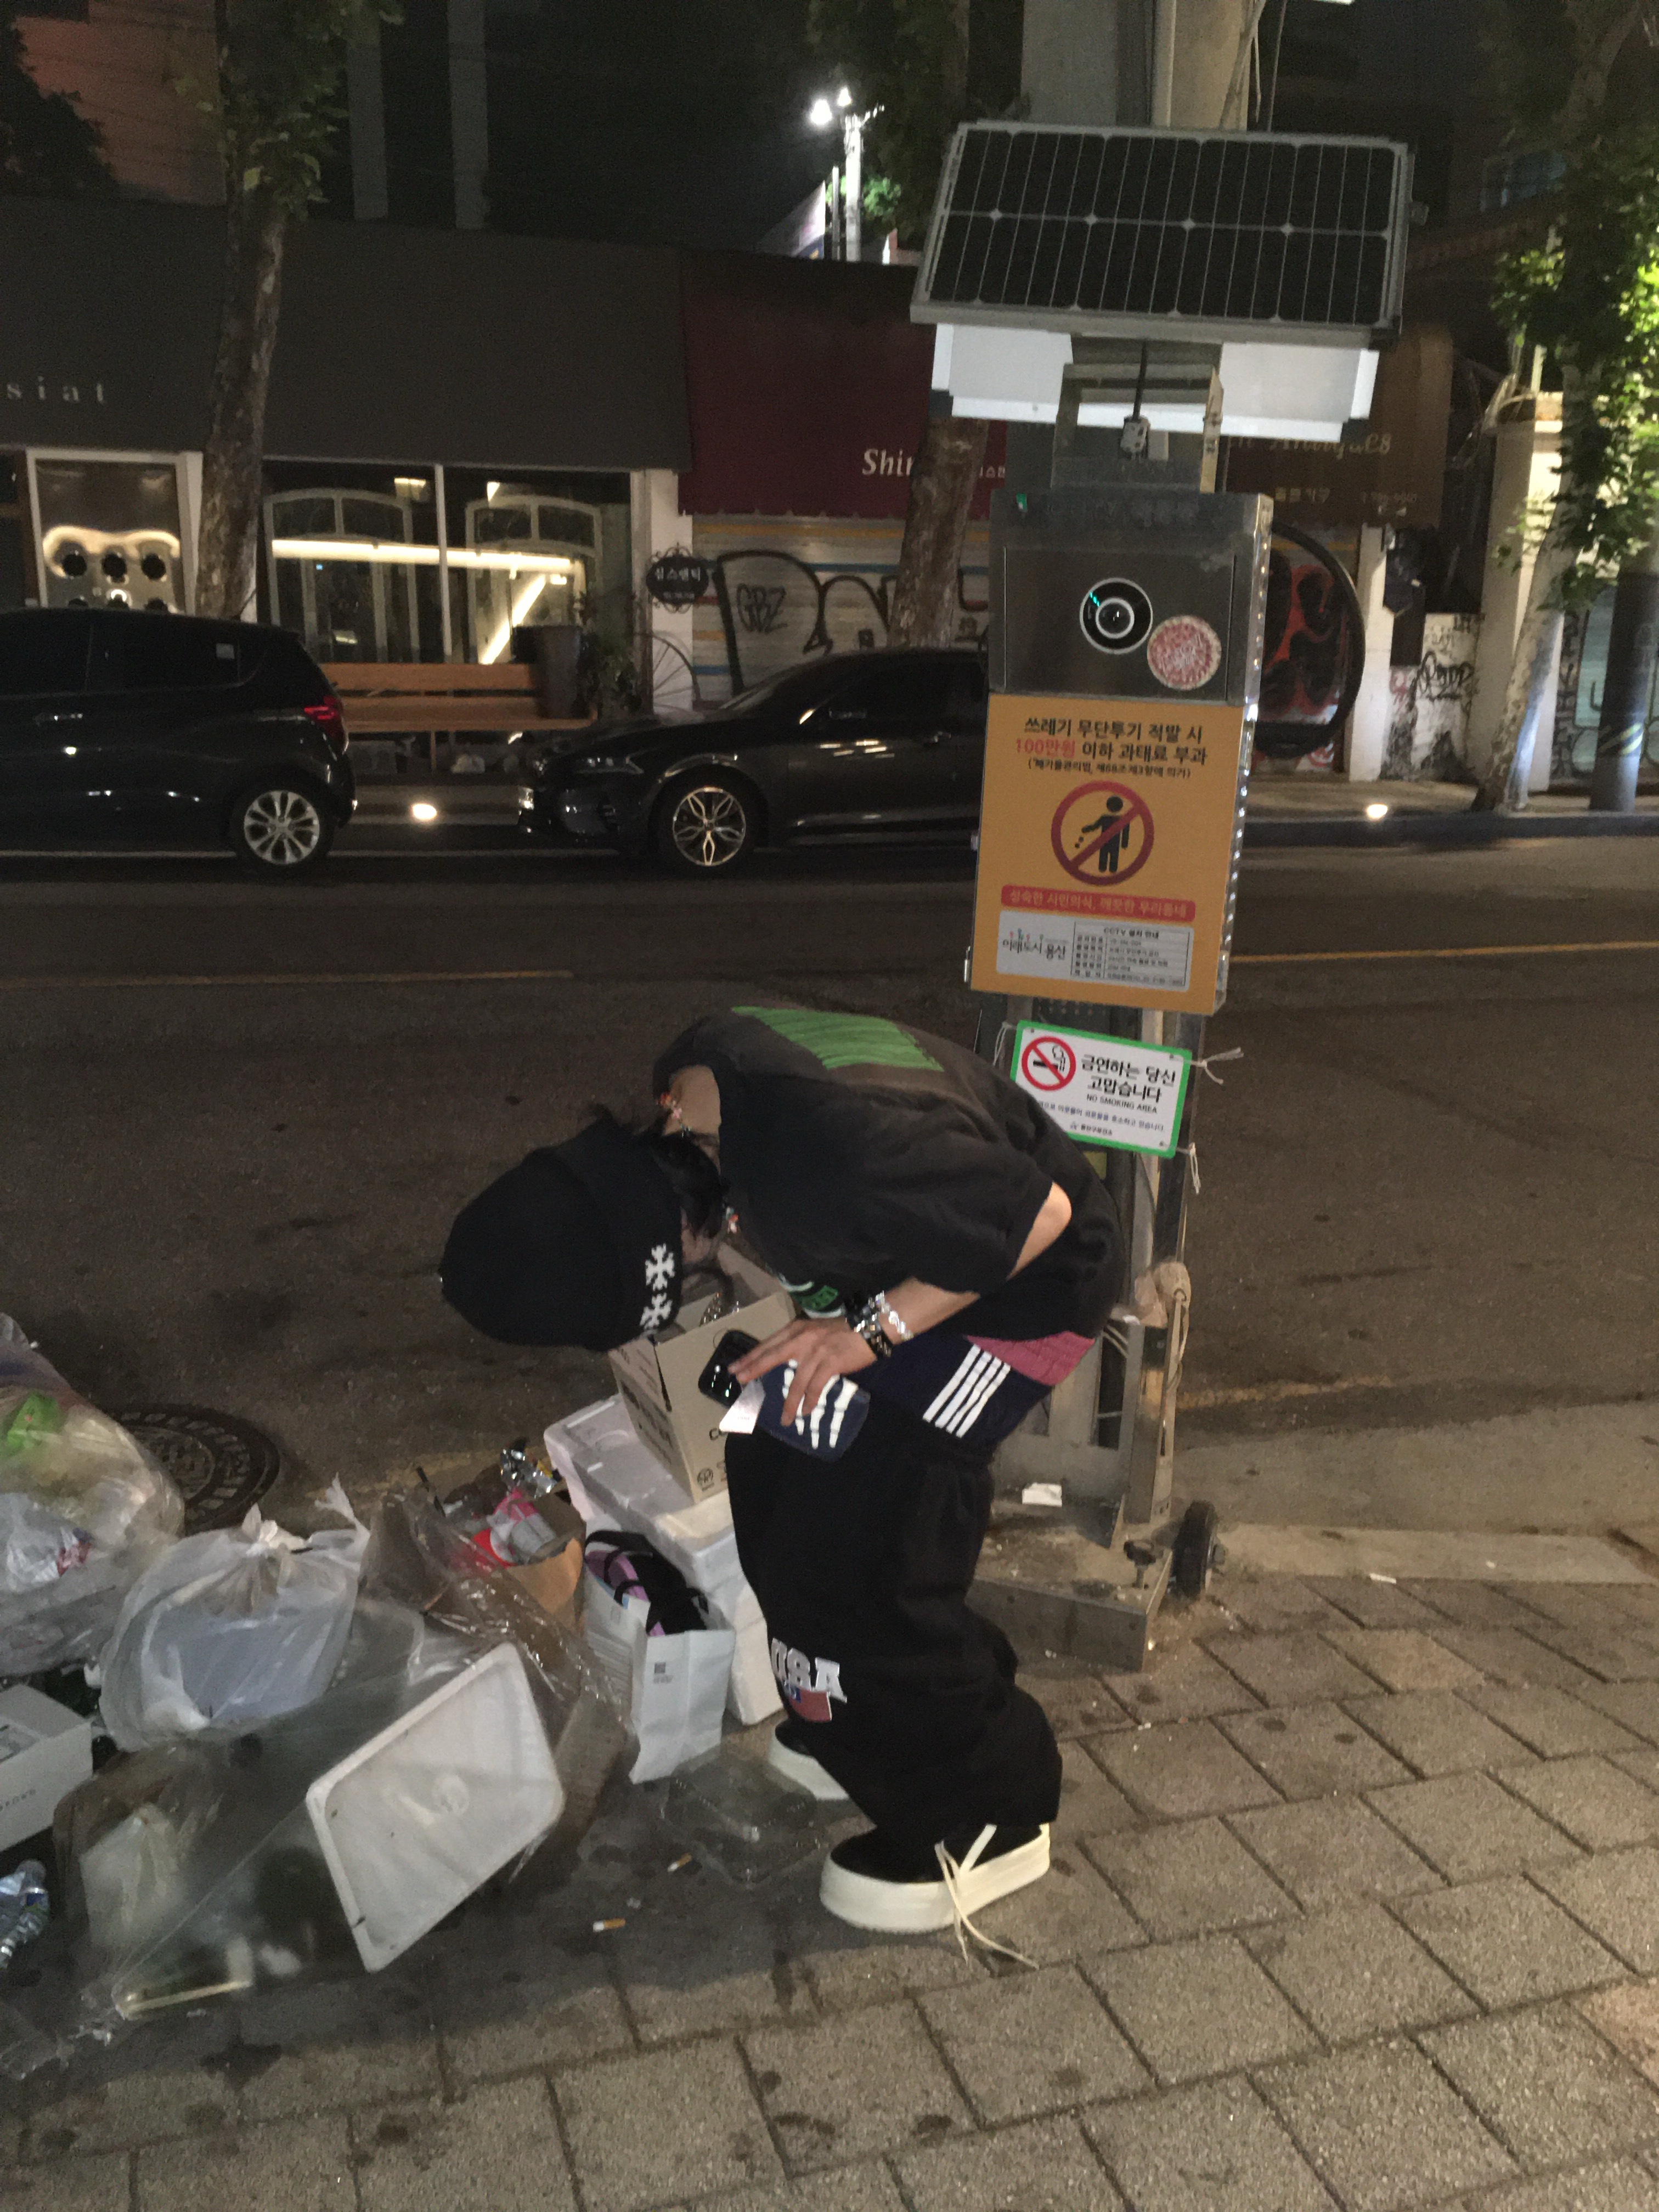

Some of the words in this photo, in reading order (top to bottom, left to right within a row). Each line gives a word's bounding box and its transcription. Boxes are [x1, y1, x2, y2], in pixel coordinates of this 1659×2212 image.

[1024, 718, 1071, 737] 쓰레기
[1079, 719, 1142, 740] 무단투기
[1149, 724, 1181, 743] 적발
[1186, 724, 1203, 744] 시
[1016, 737, 1075, 759] 100만원
[1082, 741, 1113, 760] 이하
[1119, 743, 1168, 763] 과태료
[1175, 746, 1208, 766] 부과
[1081, 1053, 1141, 1081] 금연하는
[1146, 1065, 1176, 1087] 당신
[1087, 1075, 1163, 1104] 고맙습니다
[1087, 1093, 1098, 1102] NO
[1099, 1096, 1135, 1110] SMOKING
[1137, 1103, 1158, 1114] AREA
